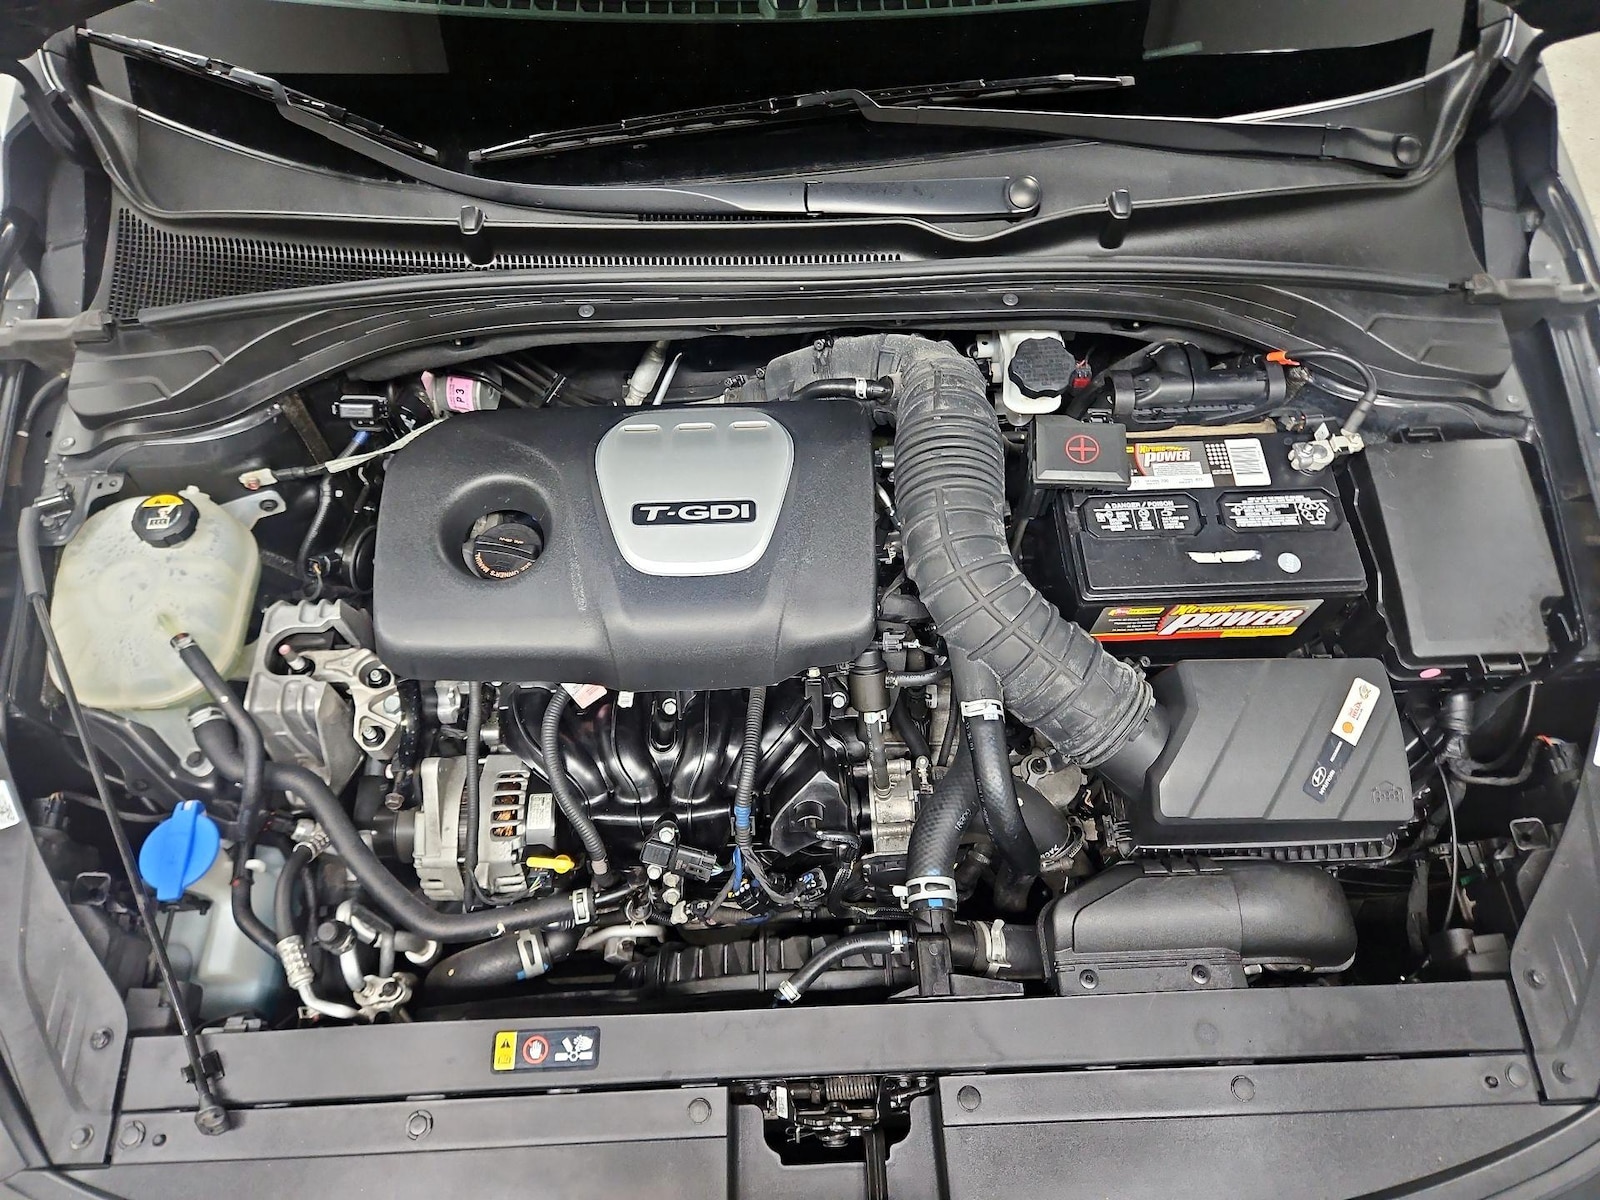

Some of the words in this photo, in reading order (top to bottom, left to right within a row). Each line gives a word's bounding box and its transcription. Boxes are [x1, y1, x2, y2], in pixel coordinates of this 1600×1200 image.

[1143, 450, 1191, 468] POWER
[639, 503, 750, 522] T-GDI
[1147, 500, 1174, 508] POISON
[1158, 609, 1305, 636] POWER
[1318, 769, 1336, 796] HYUNDAI
